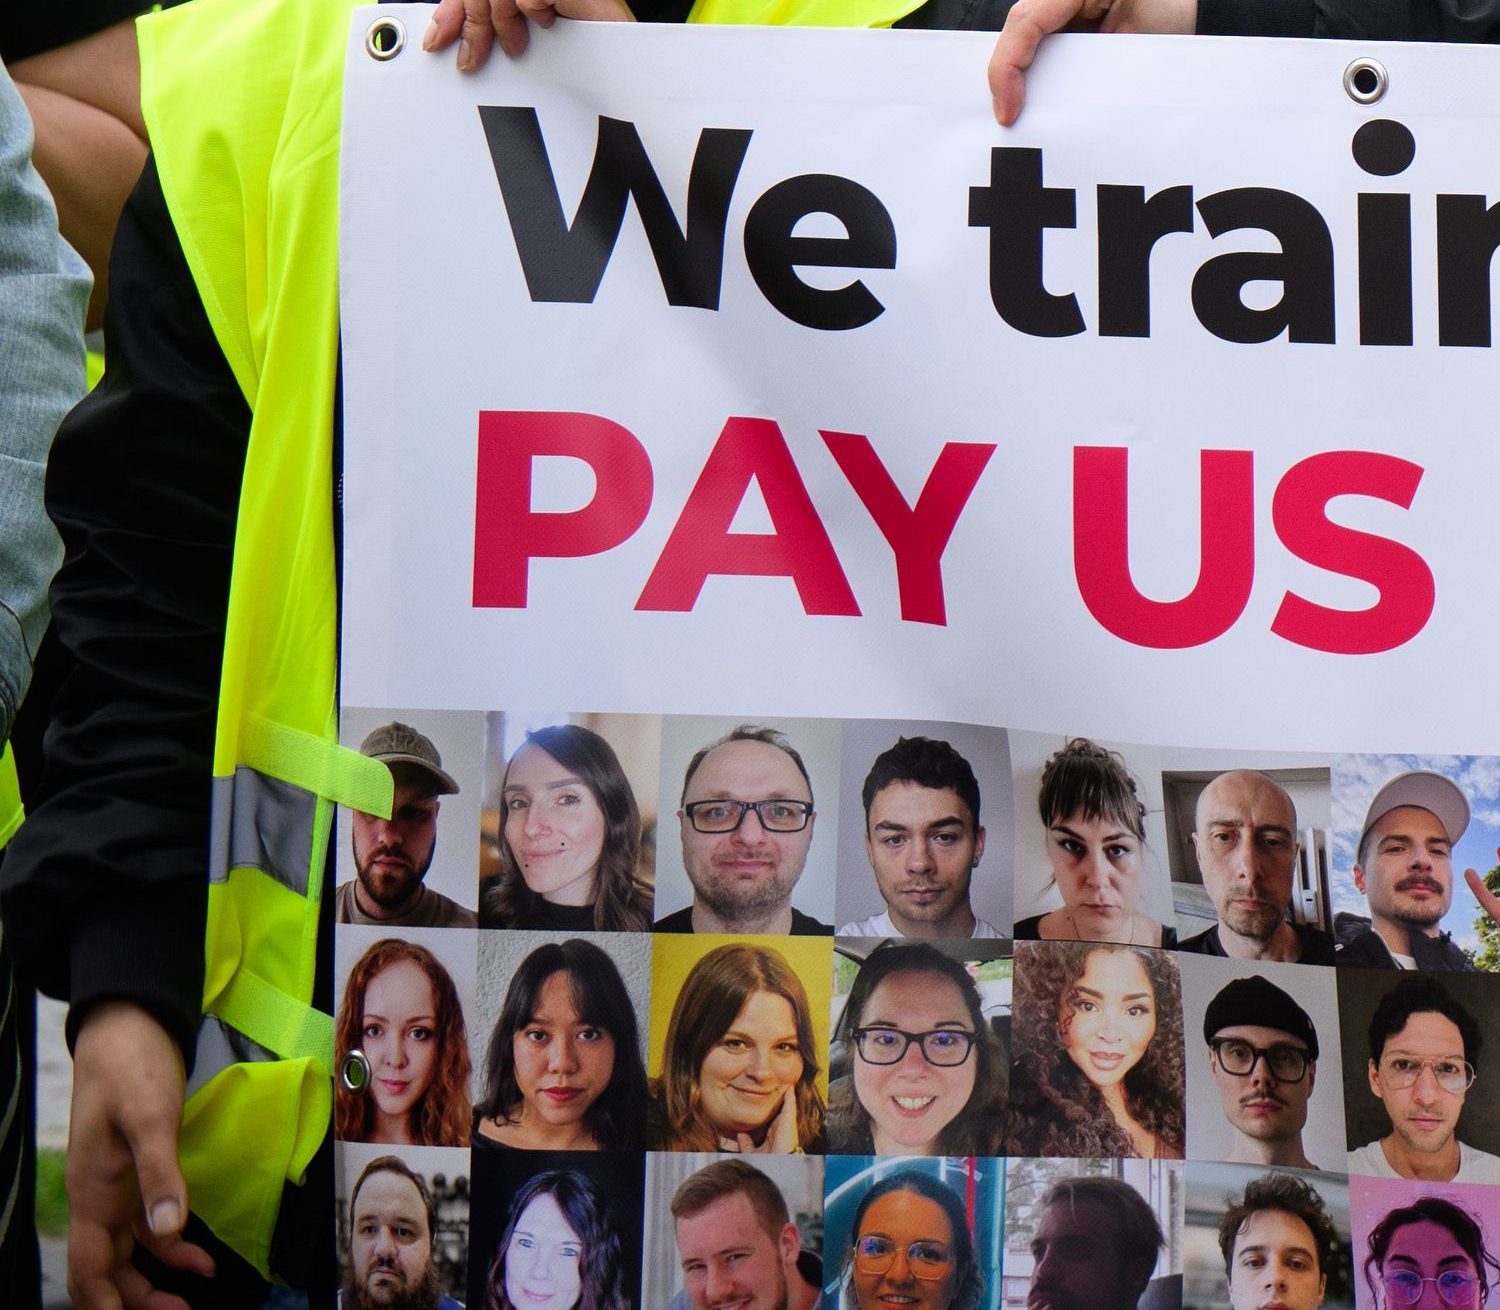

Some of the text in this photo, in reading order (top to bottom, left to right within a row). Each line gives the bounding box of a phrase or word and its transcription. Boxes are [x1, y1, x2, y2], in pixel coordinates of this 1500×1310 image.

[477, 105, 895, 331] We
[471, 410, 997, 627] PAY
[1072, 445, 1436, 656] US
